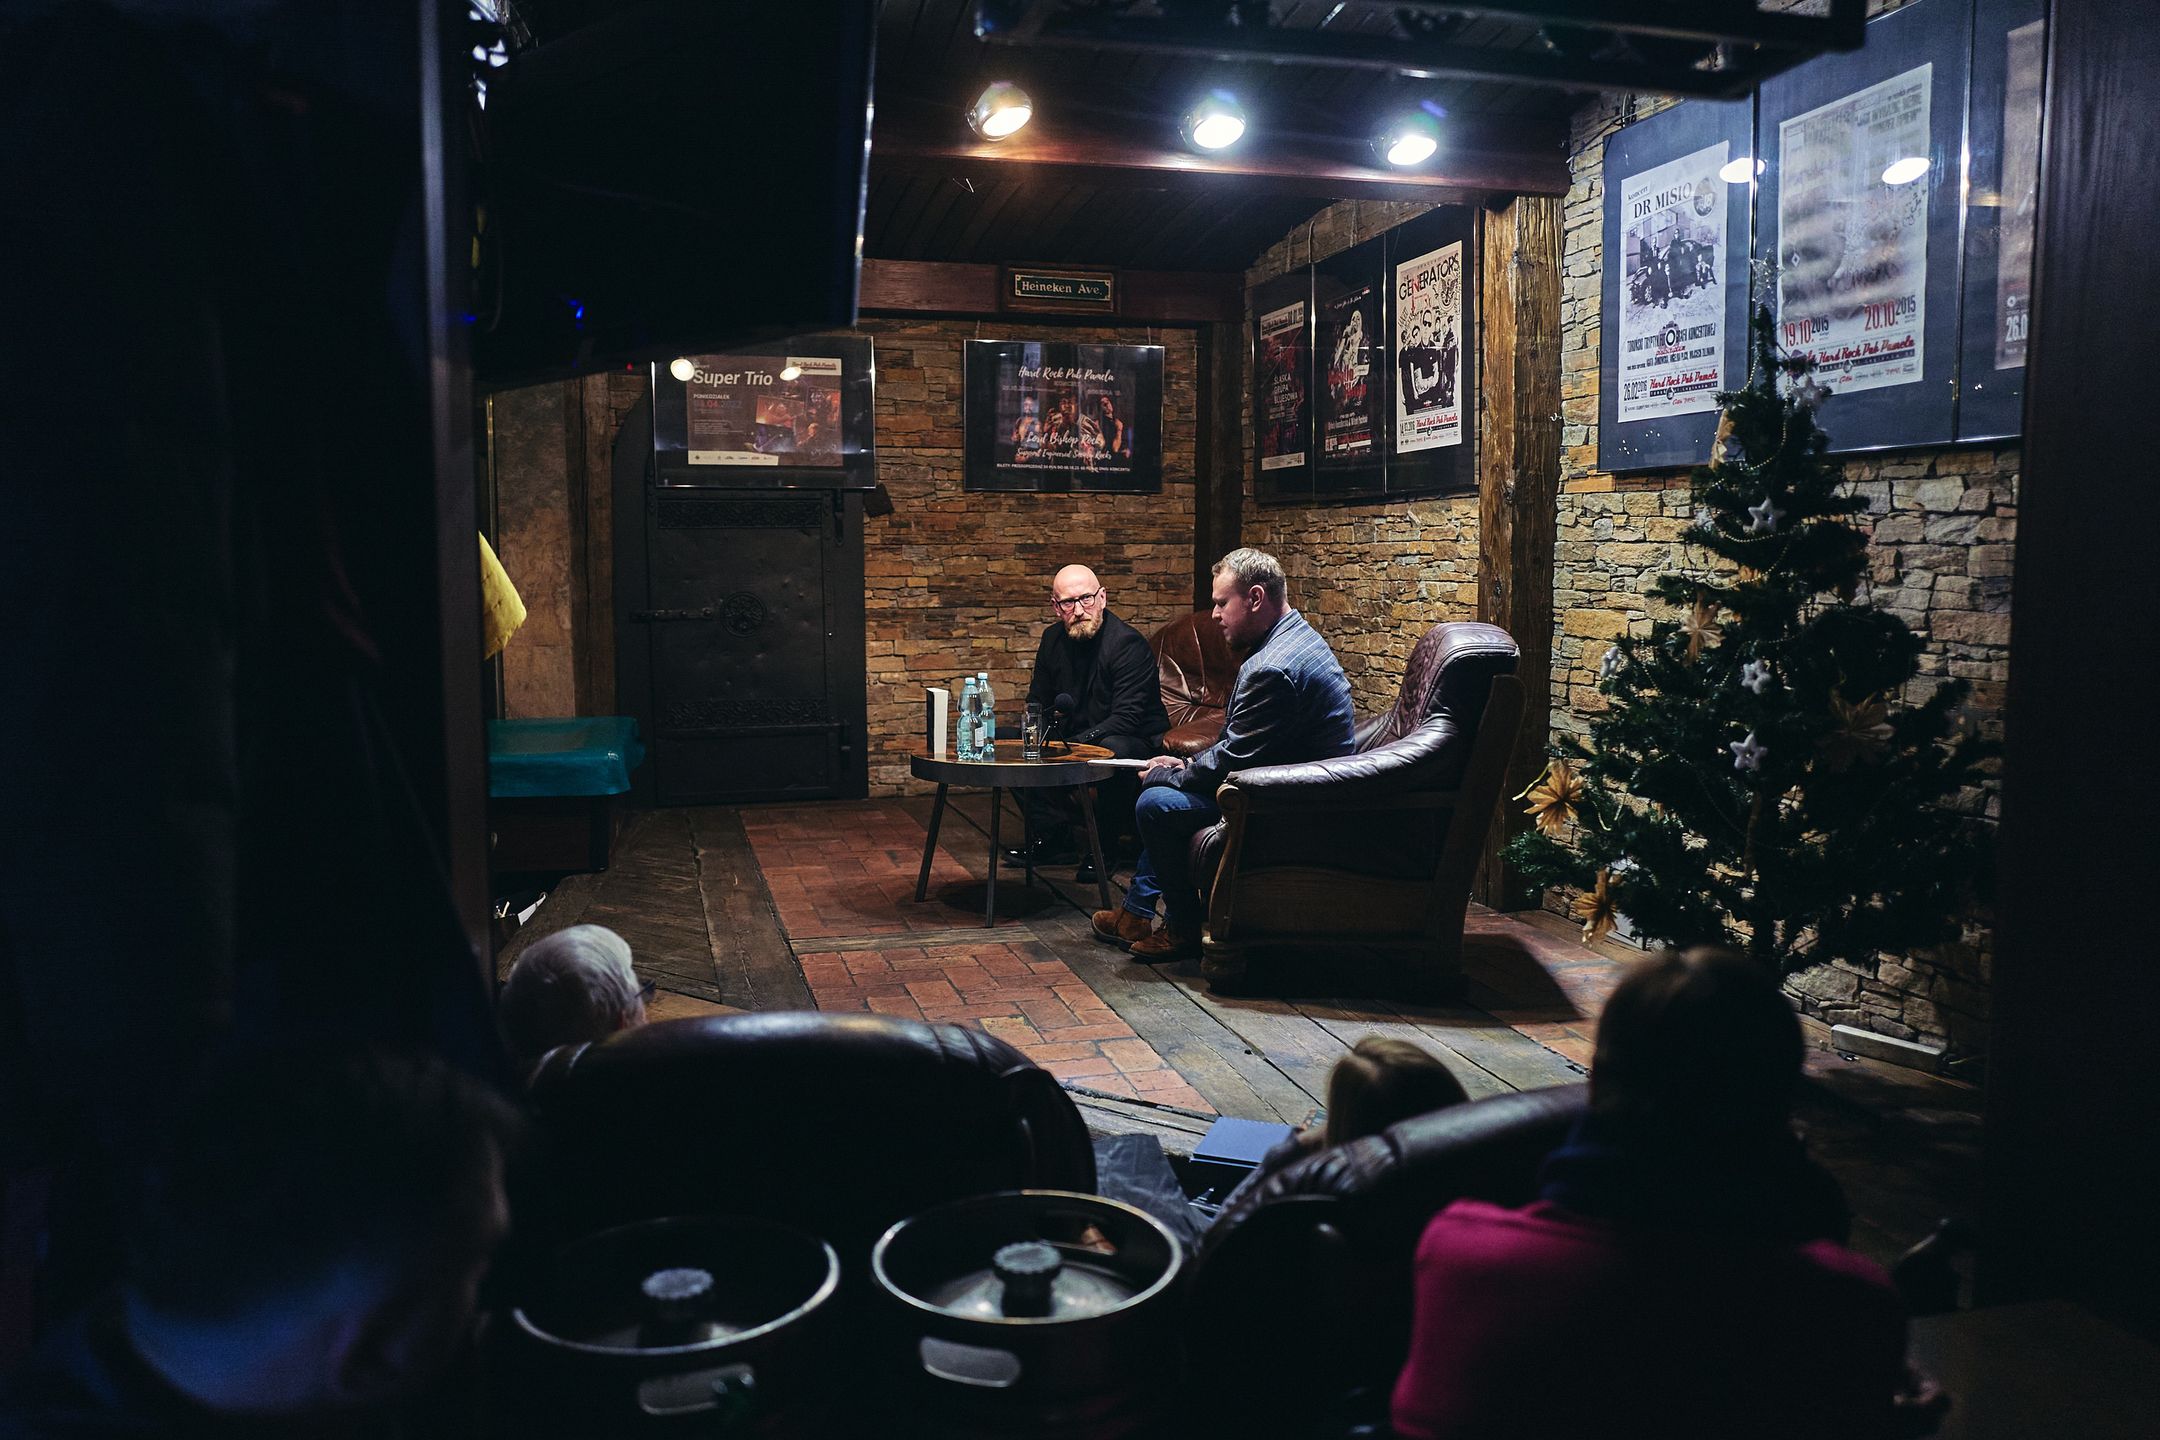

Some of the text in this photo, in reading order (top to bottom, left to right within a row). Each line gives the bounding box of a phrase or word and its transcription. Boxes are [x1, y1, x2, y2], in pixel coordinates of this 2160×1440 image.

[1628, 185, 1648, 200] koncert
[1634, 182, 1692, 219] DR MISIO
[1399, 253, 1460, 300] GENERATORS
[1022, 281, 1103, 295] Heineken Ave.
[1819, 349, 1840, 363] Hard
[1842, 345, 1861, 360] Rock
[1862, 341, 1879, 355] Pub
[1881, 335, 1915, 353] Pamela
[693, 370, 773, 387] Super Trio
[1018, 366, 1115, 382] Hard Rock Pub Pamela
[1650, 369, 1718, 389] Hard Rock Pub Pamela
[1049, 430, 1079, 447] Bishop
